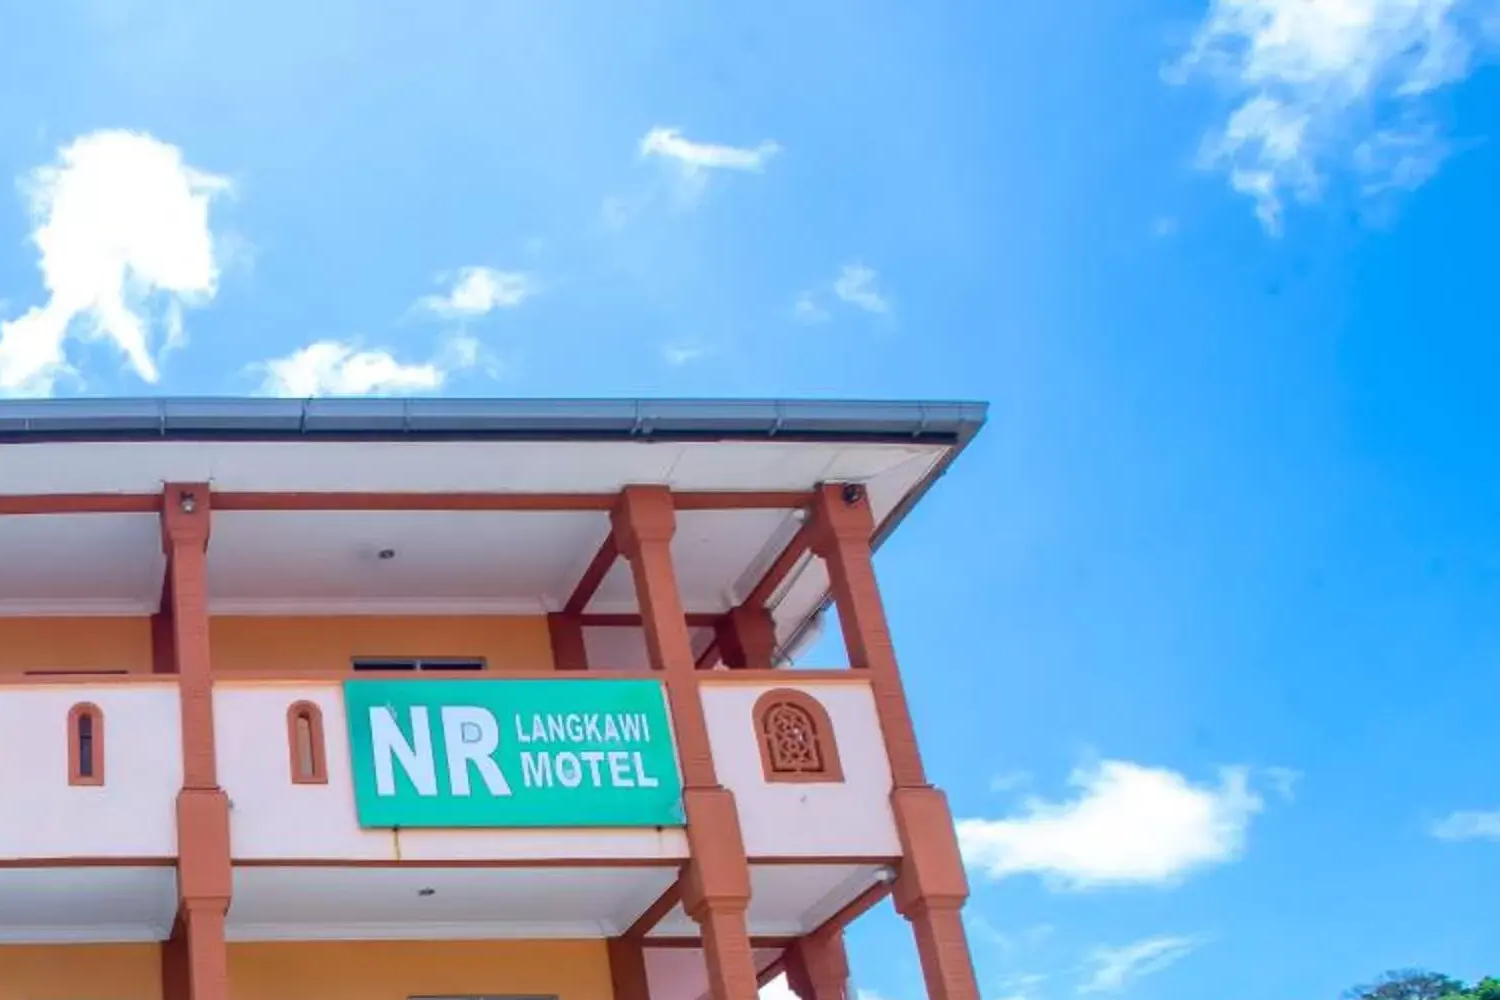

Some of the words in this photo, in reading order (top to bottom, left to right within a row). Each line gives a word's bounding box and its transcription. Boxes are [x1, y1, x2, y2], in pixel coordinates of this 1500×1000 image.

[515, 712, 650, 743] LANGKAWI
[368, 705, 512, 796] NR
[519, 751, 659, 788] MOTEL
